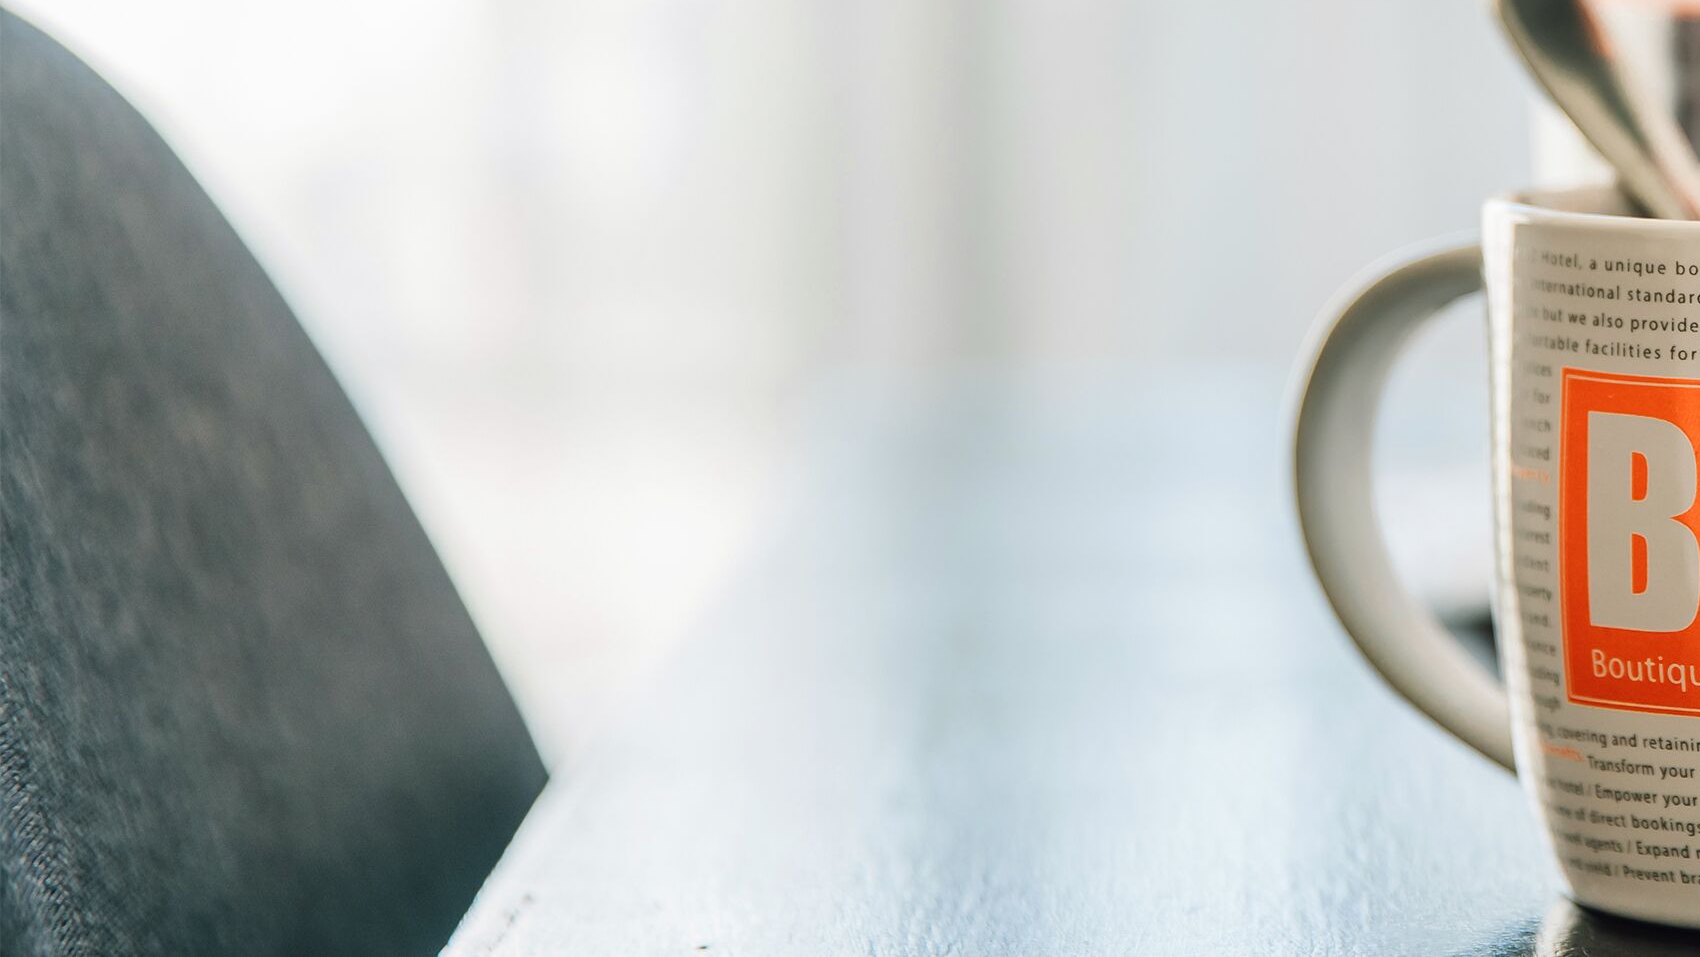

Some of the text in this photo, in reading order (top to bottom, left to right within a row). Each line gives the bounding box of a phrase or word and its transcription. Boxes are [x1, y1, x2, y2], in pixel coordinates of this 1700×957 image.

[1589, 259, 1597, 270] a
[1605, 259, 1666, 277] unique
[1568, 314, 1586, 325] we
[1592, 313, 1624, 329] also
[1630, 317, 1699, 333] provide
[1585, 339, 1661, 359] facilities
[1670, 345, 1697, 361] for
[1612, 734, 1637, 747] and
[1586, 755, 1655, 775] Transform
[1659, 767, 1695, 780] your
[1594, 784, 1658, 805] Empower
[1662, 795, 1698, 808] your
[1635, 840, 1690, 859] Expand
[1622, 865, 1675, 883] Prevent
